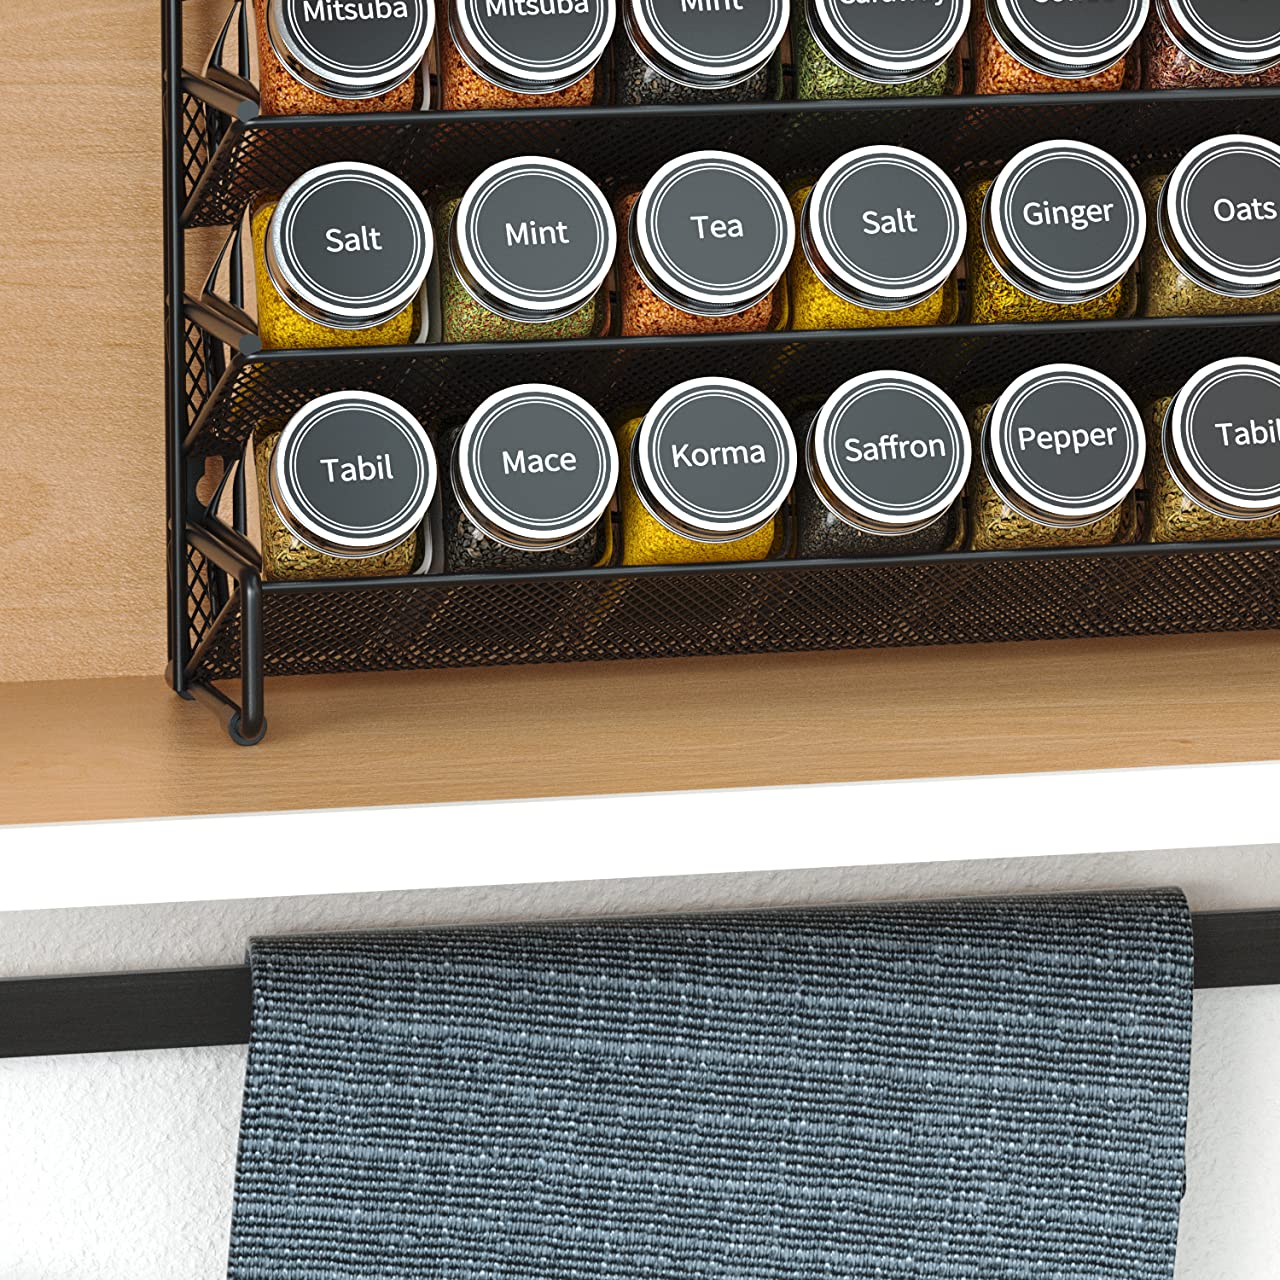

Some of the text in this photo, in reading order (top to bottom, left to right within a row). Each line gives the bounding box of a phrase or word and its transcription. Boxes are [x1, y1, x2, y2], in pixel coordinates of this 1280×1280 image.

[862, 207, 918, 235] Salt
[1022, 200, 1114, 231] Ginger
[1213, 198, 1278, 222] Oats
[325, 225, 383, 253] Salt
[505, 220, 570, 247] Mint
[689, 215, 744, 239] Tea
[844, 433, 946, 462] Saffron
[1017, 426, 1118, 455] Pepper
[319, 453, 394, 483] Tabil
[502, 449, 577, 475] Mace
[671, 443, 766, 468] Korma
